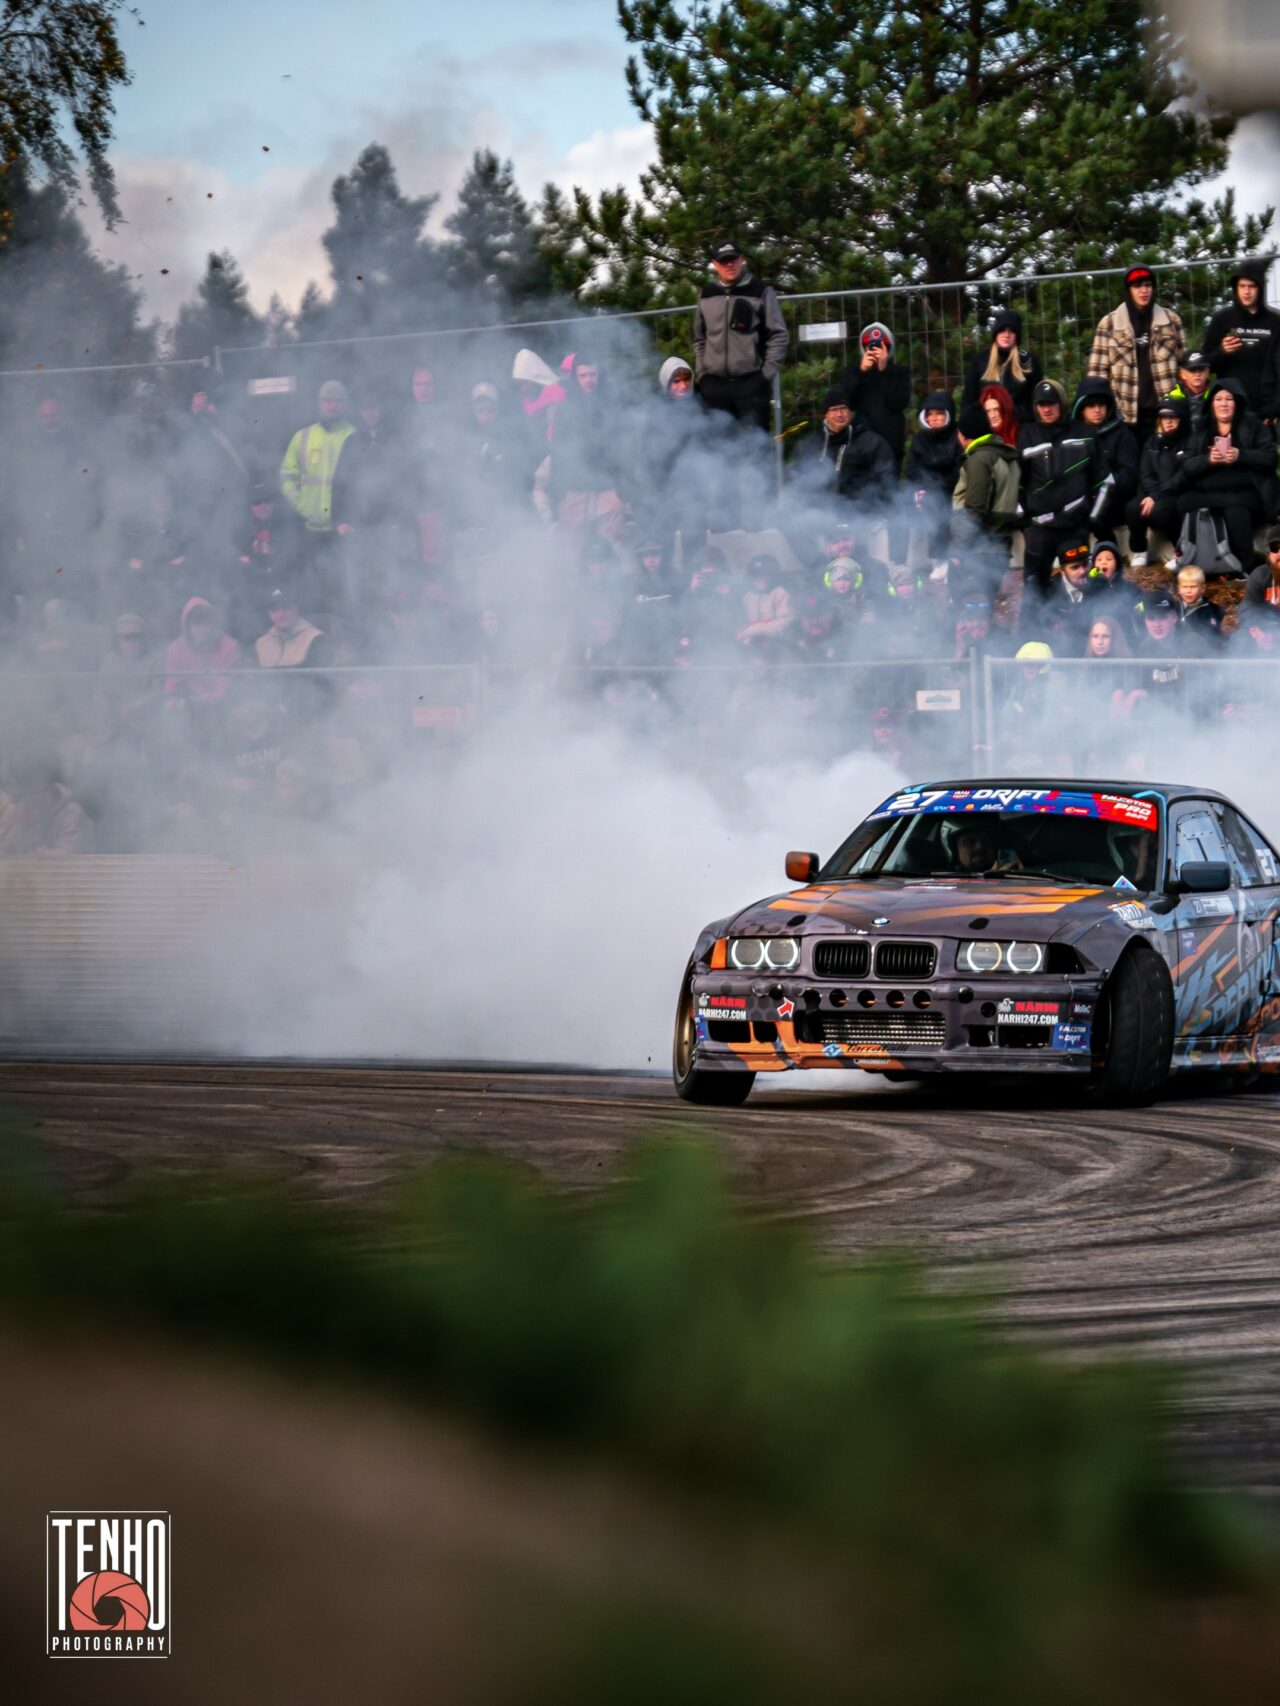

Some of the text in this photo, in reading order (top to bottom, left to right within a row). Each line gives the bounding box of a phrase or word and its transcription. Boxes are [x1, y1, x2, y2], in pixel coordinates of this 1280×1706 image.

[886, 790, 949, 811] 27
[972, 789, 1051, 806] DRIFT
[1113, 803, 1152, 815] PRO
[1255, 848, 1277, 877] 27
[997, 1013, 1059, 1025] NARHI247.COM
